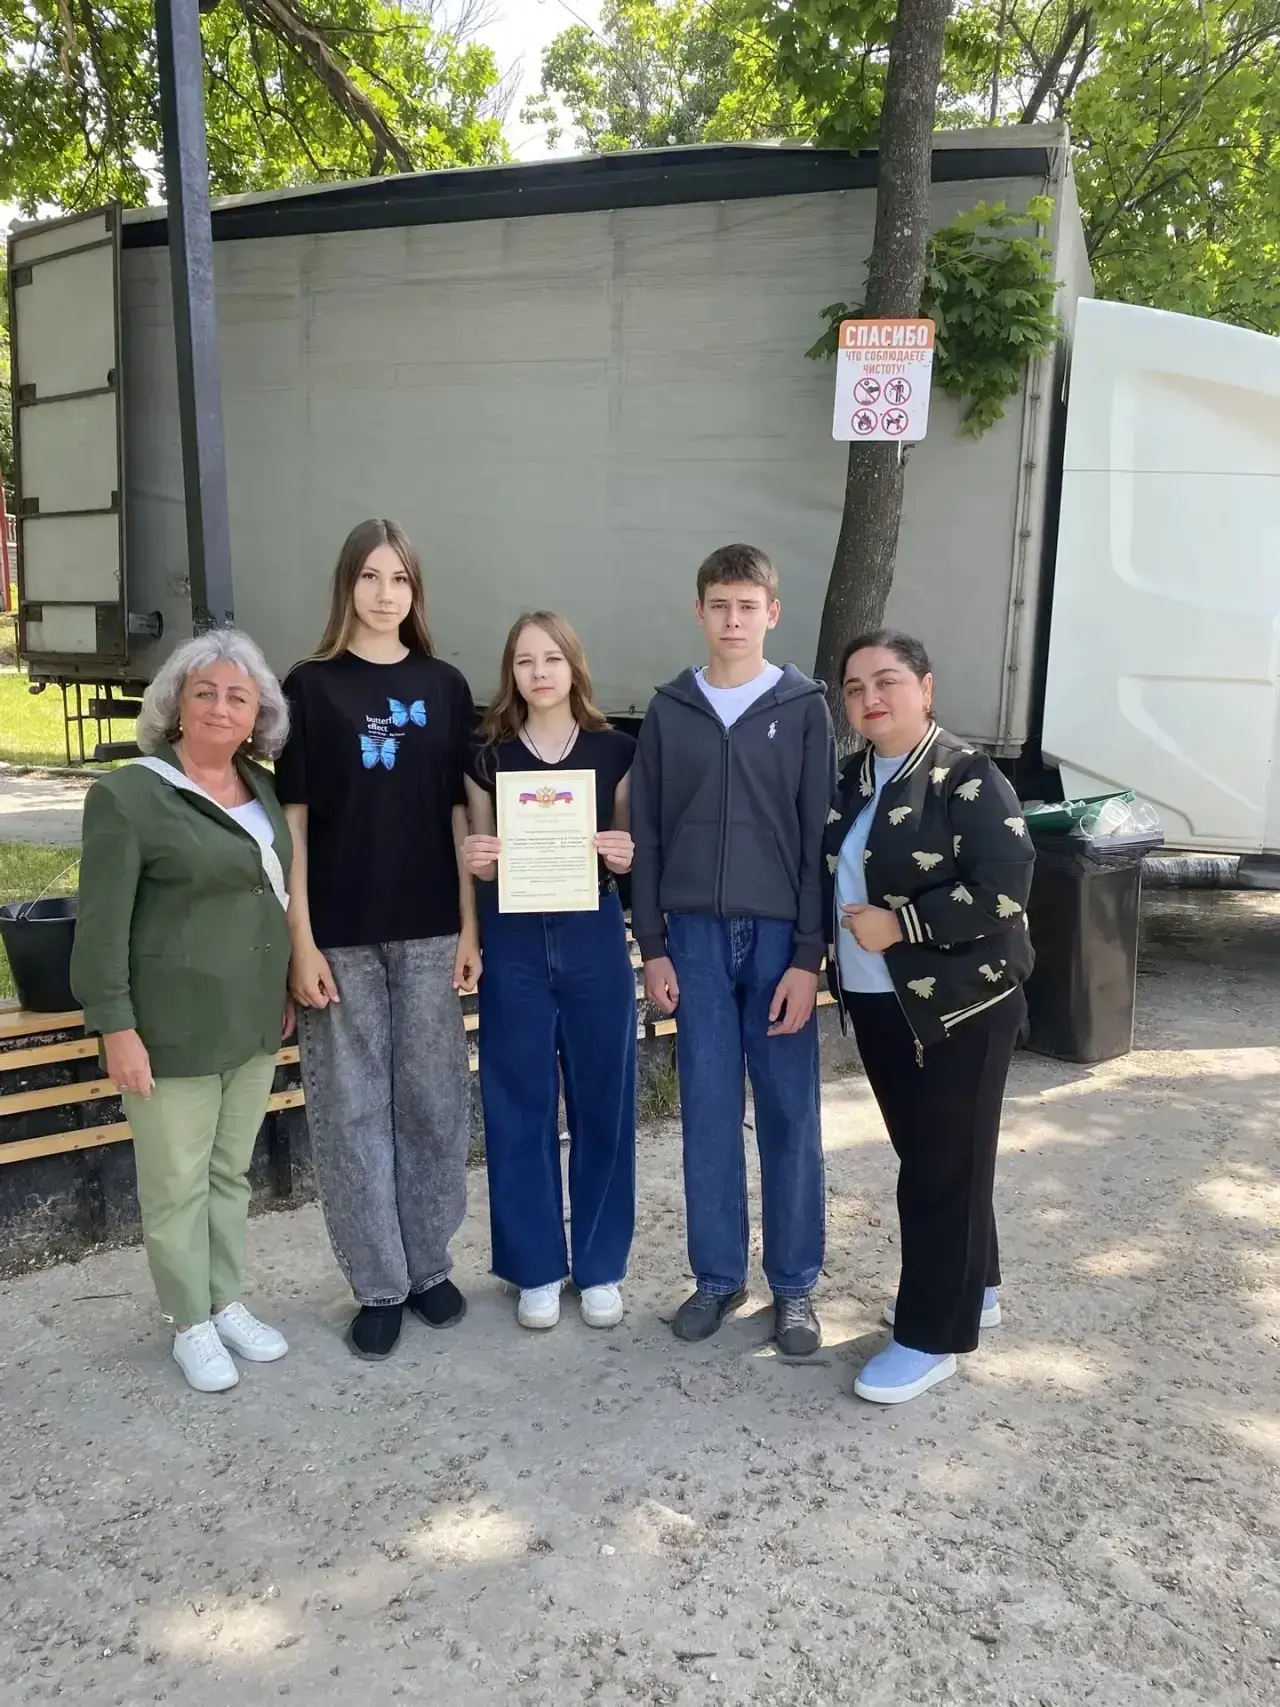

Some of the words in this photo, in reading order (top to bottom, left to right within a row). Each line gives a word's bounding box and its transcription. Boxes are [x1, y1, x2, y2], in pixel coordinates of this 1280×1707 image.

[846, 325, 928, 347] СПАСИБО
[846, 350, 861, 361] ЧТО
[864, 350, 925, 362] СОБЛЮДАЕТЕ
[863, 364, 905, 374] ЧИСТОТУ!
[367, 723, 389, 732] effect
